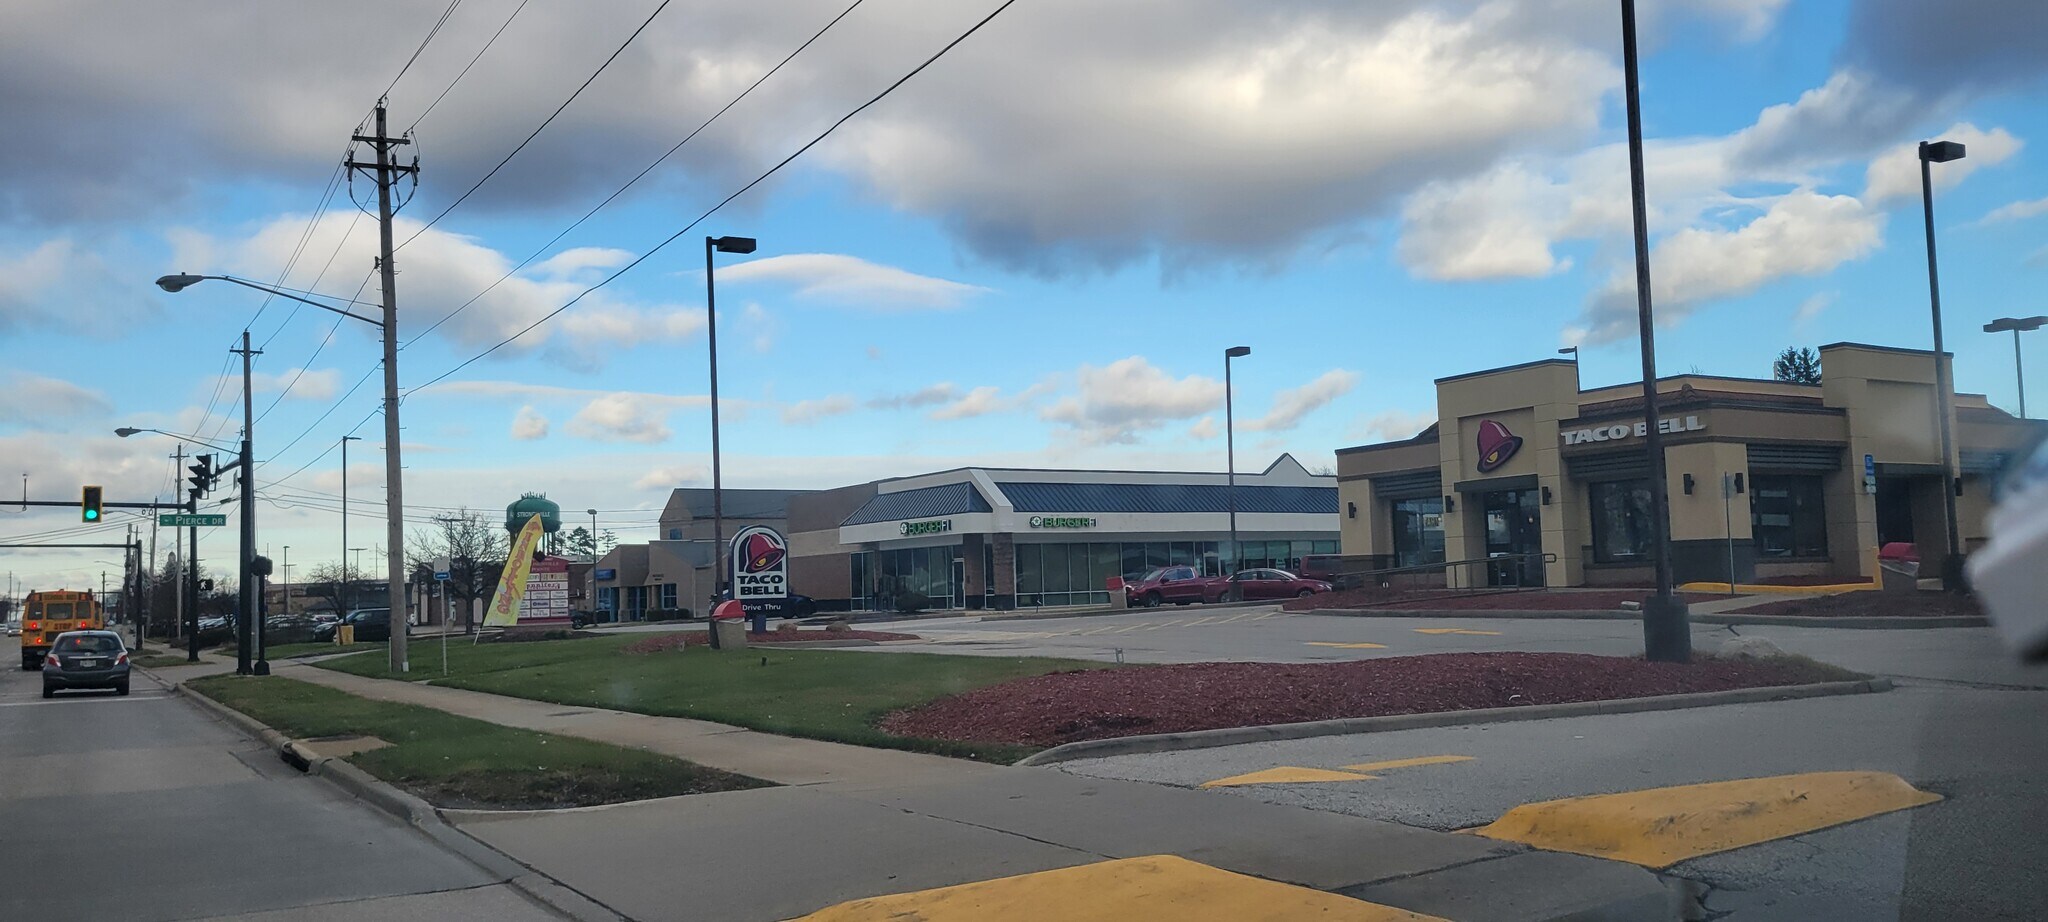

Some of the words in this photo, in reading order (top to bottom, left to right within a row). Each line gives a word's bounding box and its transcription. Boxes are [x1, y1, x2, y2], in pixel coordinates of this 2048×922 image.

[1561, 425, 1631, 445] TACO
[1634, 416, 1706, 437] BELL
[175, 516, 207, 525] PIERCE
[737, 574, 784, 585] TACO
[740, 586, 785, 596] BELL
[54, 622, 73, 630] STOP
